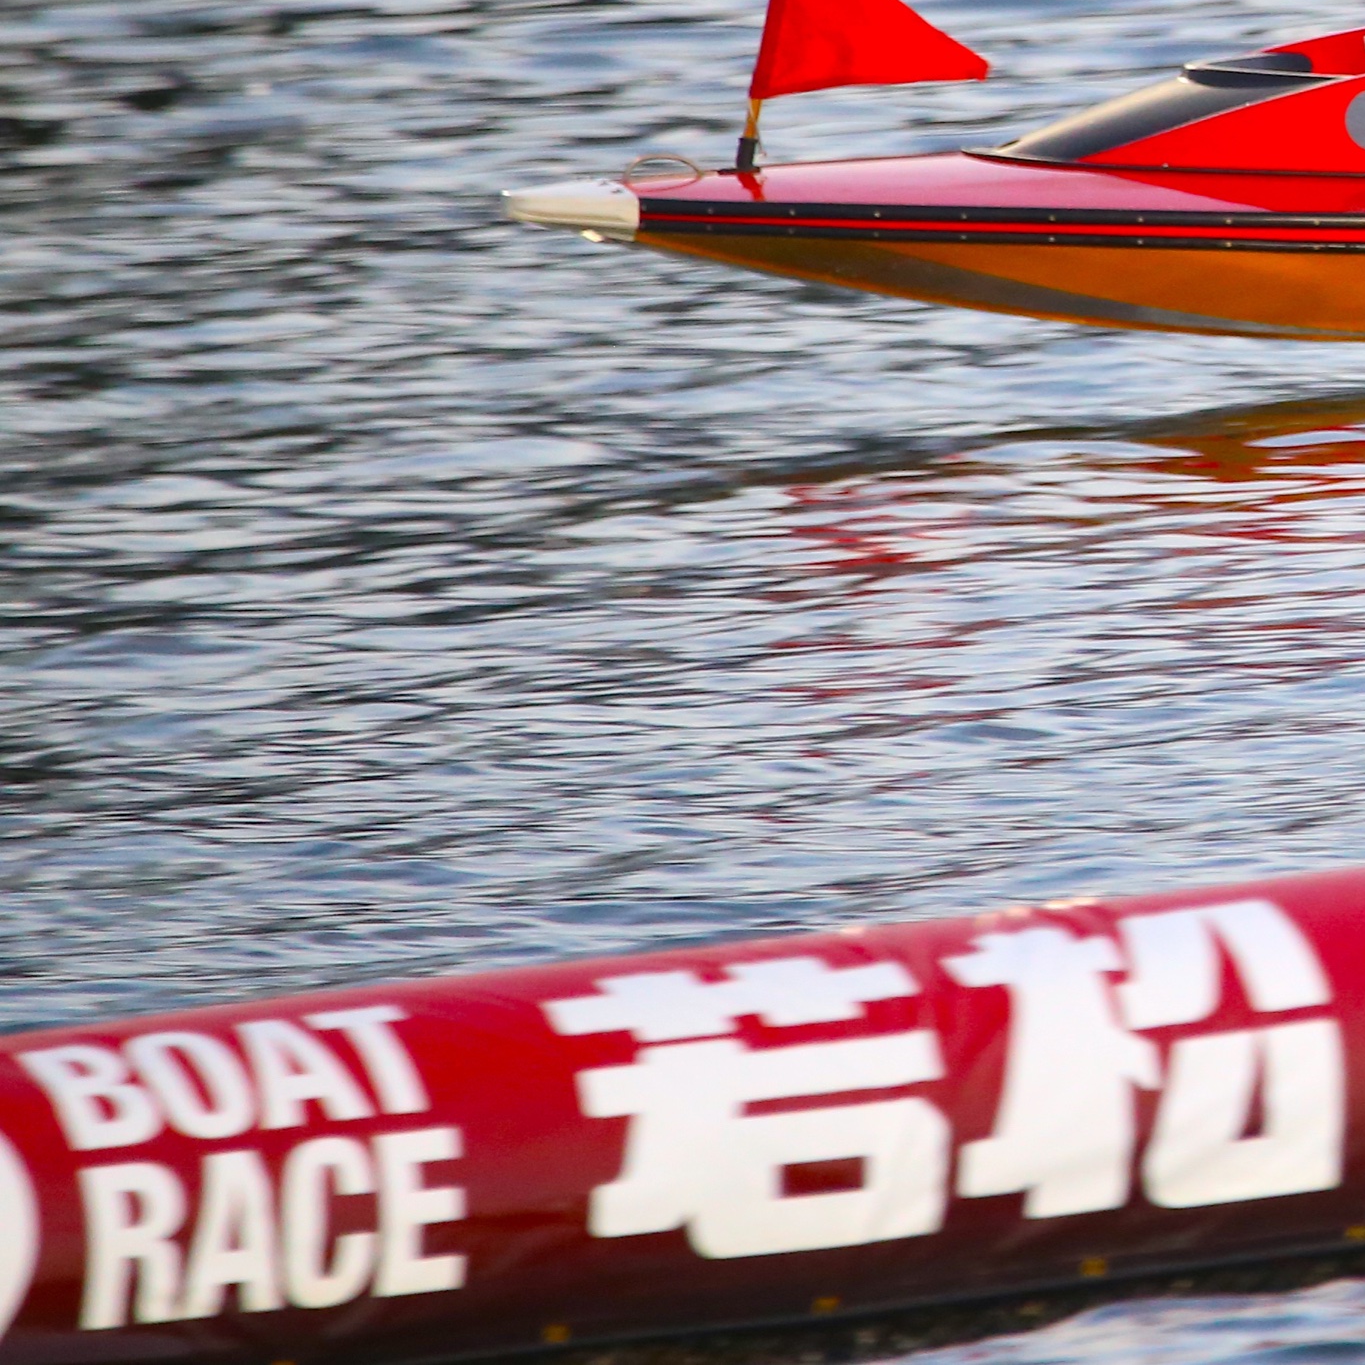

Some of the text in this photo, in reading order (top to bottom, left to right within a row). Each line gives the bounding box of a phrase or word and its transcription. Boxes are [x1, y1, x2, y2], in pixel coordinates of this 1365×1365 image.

[16, 1005, 433, 1152] BOAT
[542, 898, 1344, 1259] 若松
[76, 1127, 468, 1331] RACE
